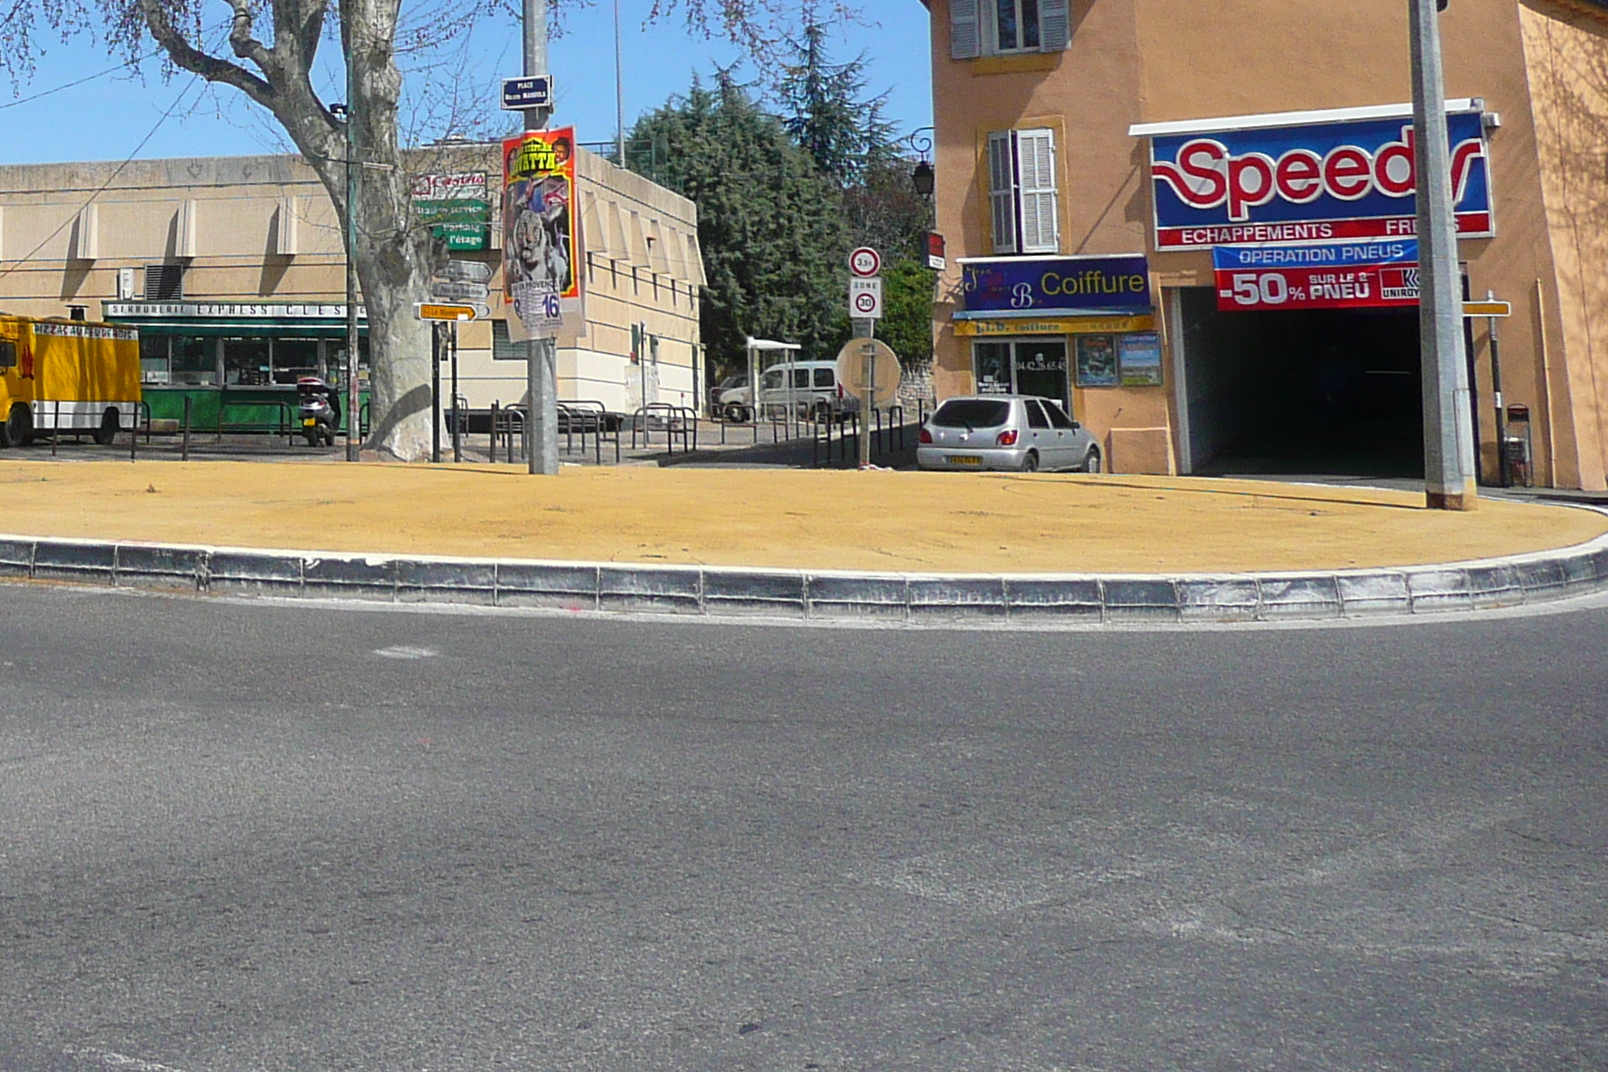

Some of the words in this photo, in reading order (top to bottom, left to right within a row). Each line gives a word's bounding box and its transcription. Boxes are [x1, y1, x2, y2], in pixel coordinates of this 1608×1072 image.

[1182, 223, 1333, 243] ECHAPPEMENTS
[1240, 248, 1336, 263] OPERATION
[1342, 244, 1404, 260] PNEUS
[1042, 271, 1144, 295] Coiffure
[1309, 274, 1336, 284] SUR
[1340, 273, 1355, 282] LE
[1310, 283, 1369, 299] PNEU
[1383, 288, 1419, 298] UNIROY
[197, 304, 268, 315] EXPRESS
[542, 294, 559, 318] 16
[859, 298, 871, 307] 30
